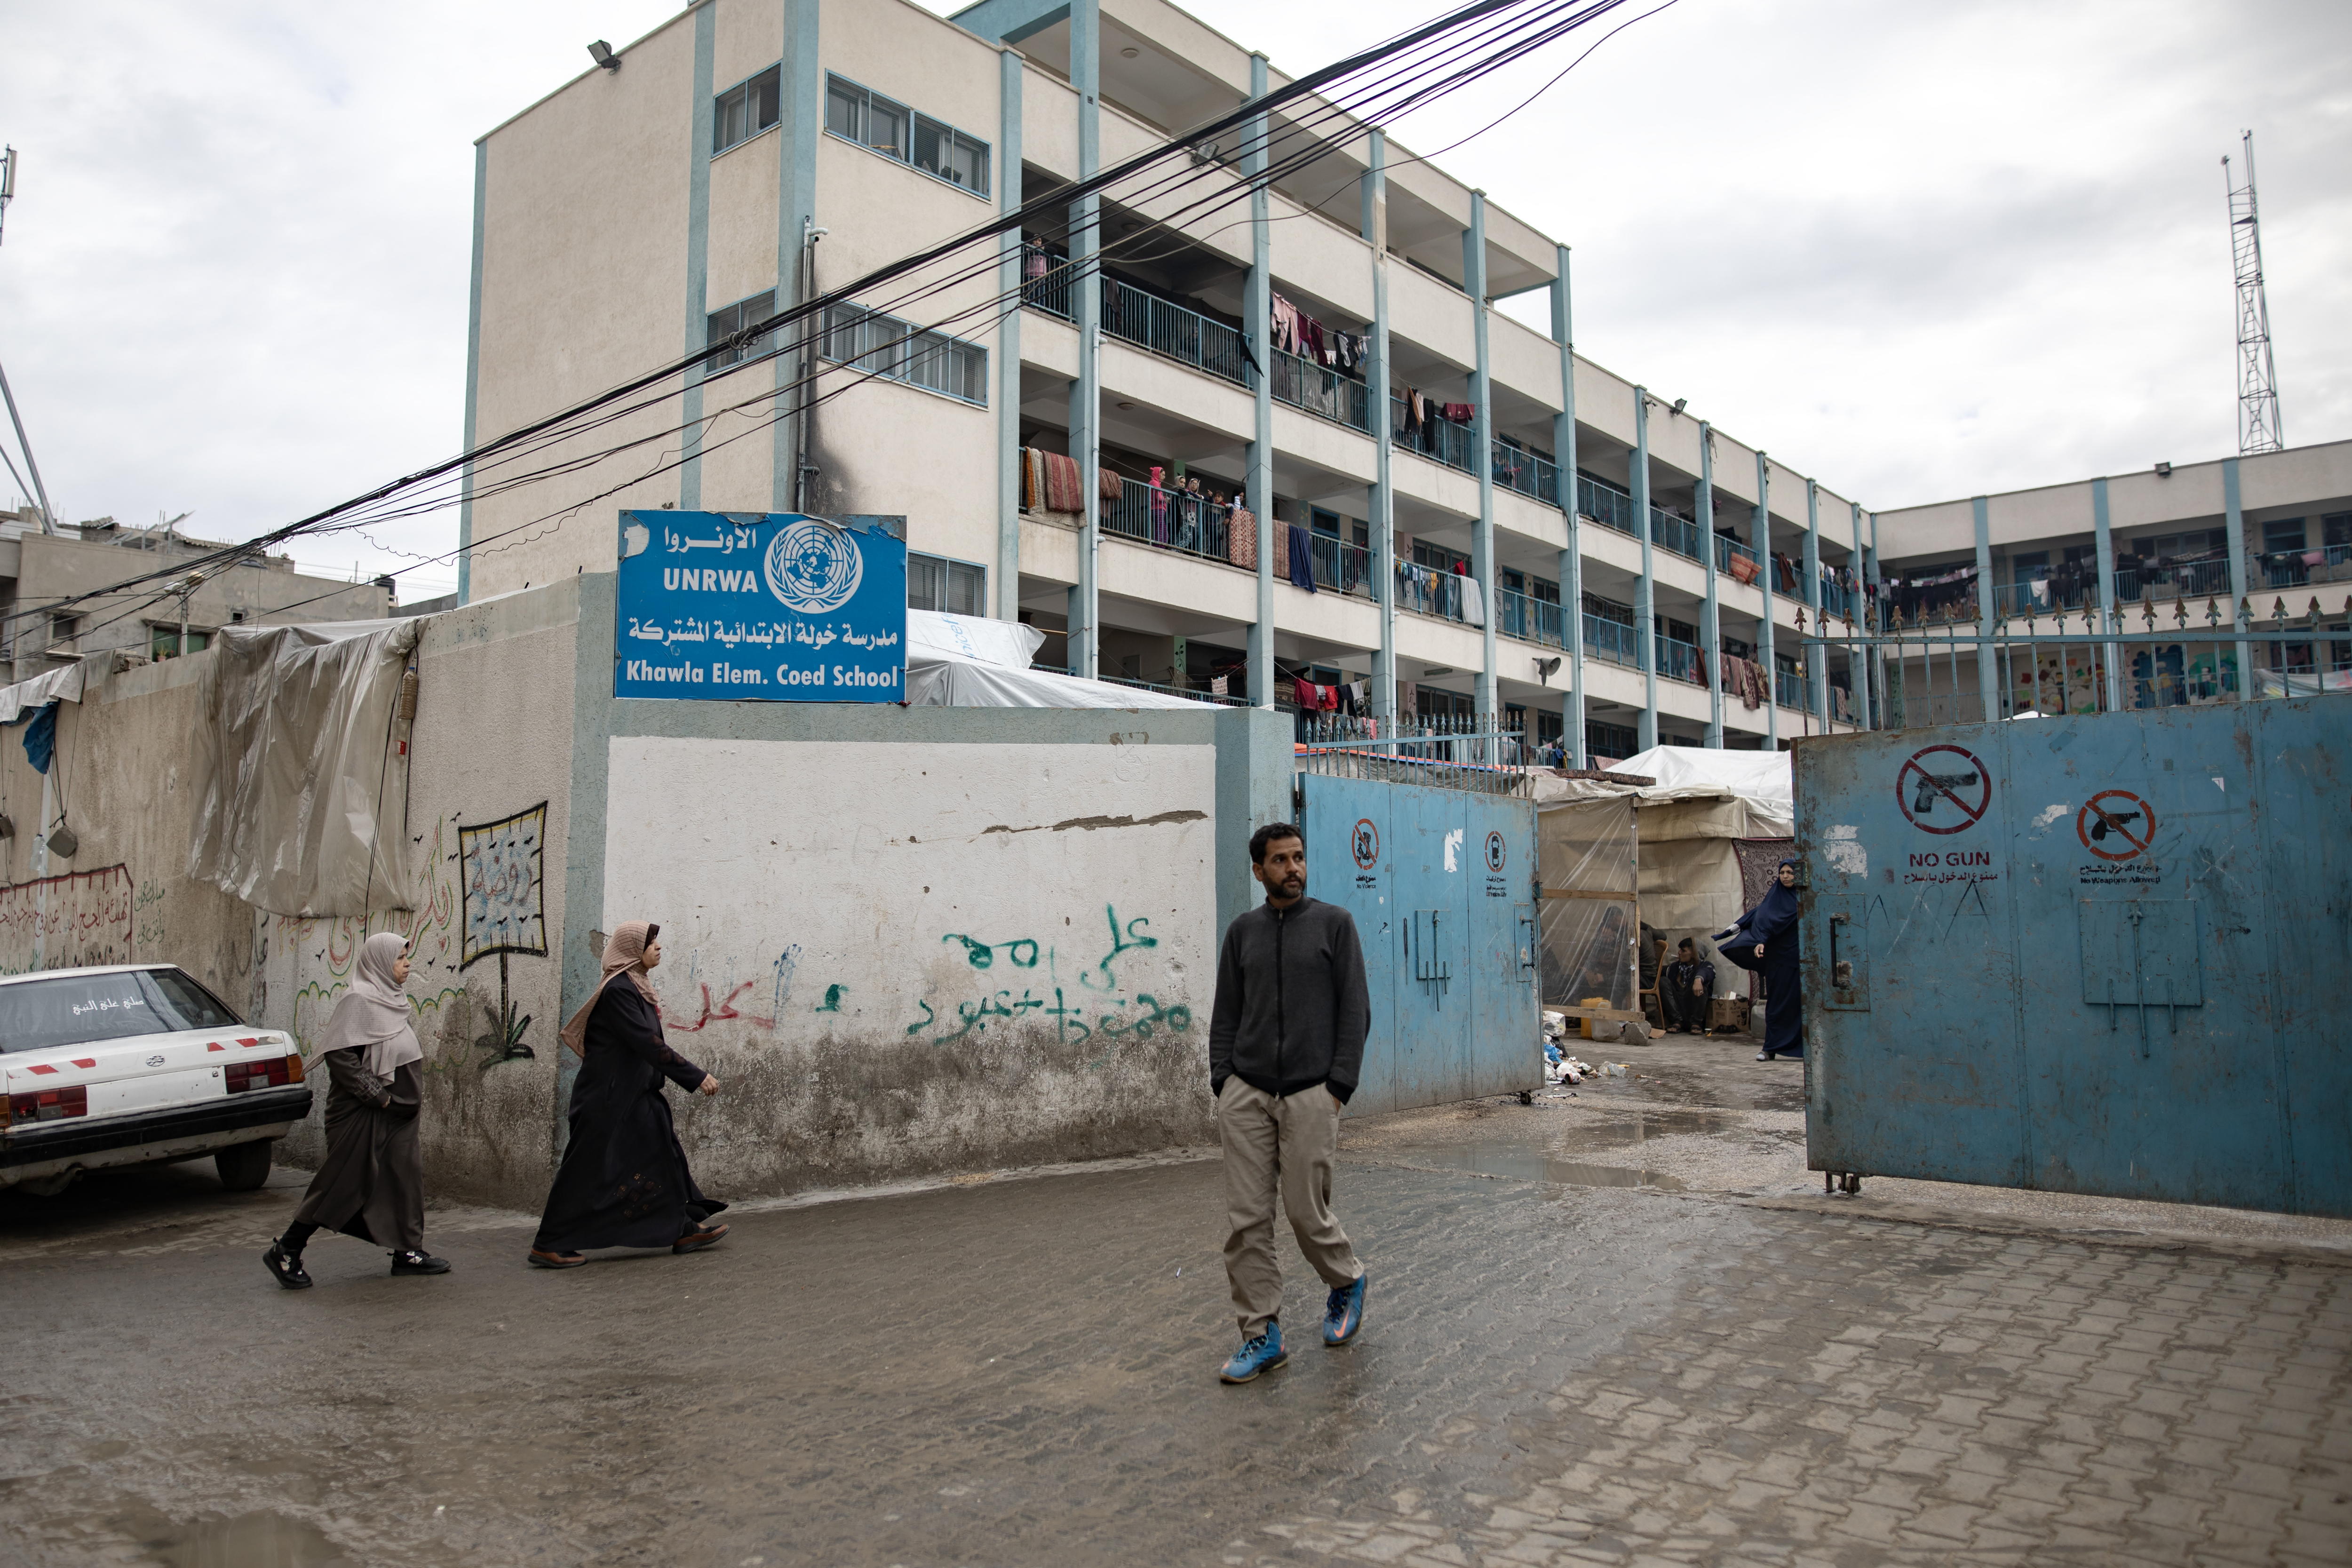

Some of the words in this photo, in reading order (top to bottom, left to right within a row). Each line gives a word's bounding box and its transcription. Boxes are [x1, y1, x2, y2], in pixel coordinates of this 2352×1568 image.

[663, 568, 758, 593] UNRWA
[628, 616, 709, 646] المشتركة
[714, 620, 791, 650] الابتدائية
[795, 620, 837, 650] خولة
[842, 623, 898, 651] مدرسة
[941, 616, 977, 660] nicef
[627, 660, 704, 684] Khawla
[712, 662, 769, 685] Elem.
[776, 664, 825, 686] Coed
[833, 665, 898, 687] School
[1909, 853, 1939, 868] NO
[1946, 852, 1990, 867] GUN
[1939, 871, 1971, 884] الدخول
[71, 1000, 98, 1016] النبي
[98, 998, 120, 1011] على
